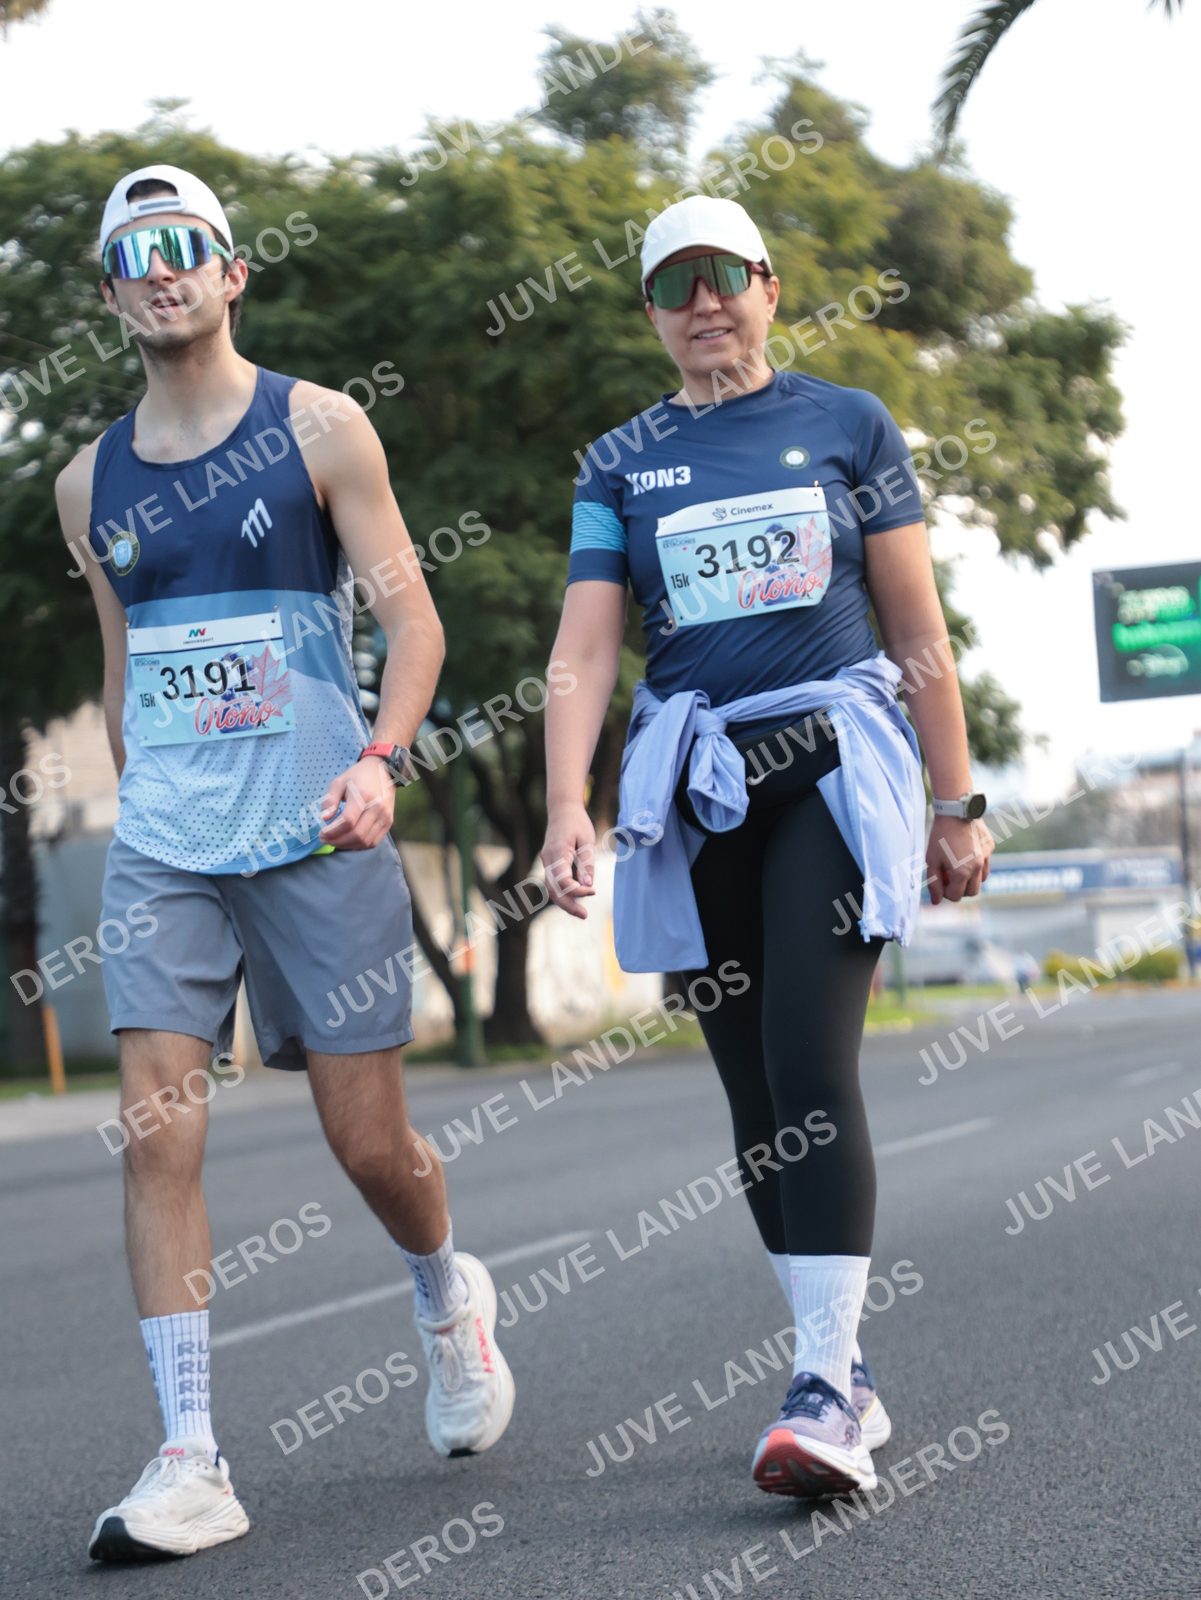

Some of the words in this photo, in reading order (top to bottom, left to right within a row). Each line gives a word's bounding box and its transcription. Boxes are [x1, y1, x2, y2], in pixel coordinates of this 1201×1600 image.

[731, 502, 774, 516] Cinemex
[695, 531, 799, 578] 3192
[159, 656, 256, 700] 3191
